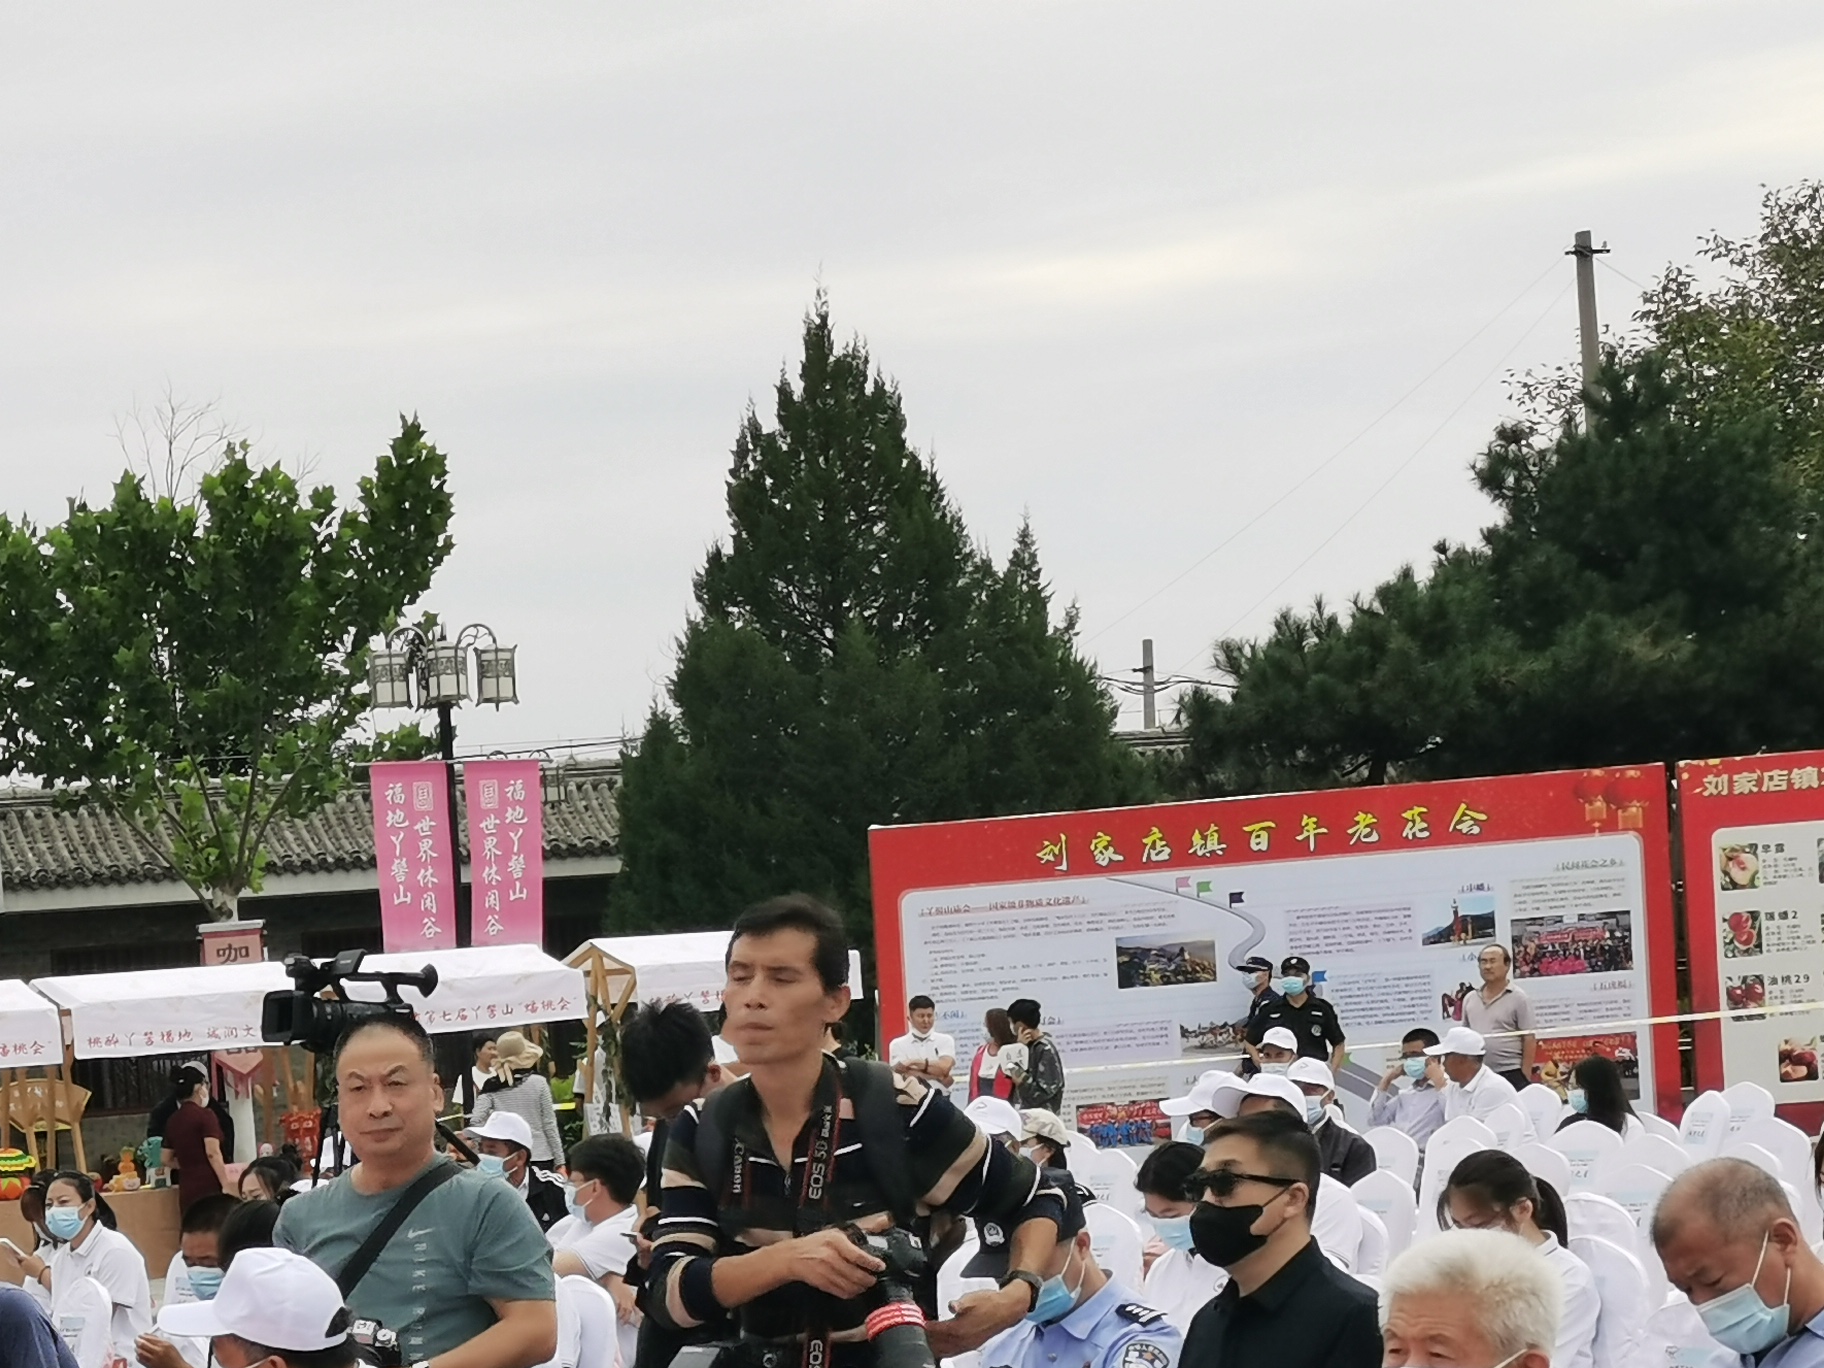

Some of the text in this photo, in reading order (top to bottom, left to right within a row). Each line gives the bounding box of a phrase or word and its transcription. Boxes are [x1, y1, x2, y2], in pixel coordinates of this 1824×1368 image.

[1702, 766, 1824, 797] 刘家店镇
[384, 782, 412, 906] 福地丫髻山
[504, 778, 529, 902] 福地丫髻山
[1035, 801, 1489, 873] 刘家店镇百年老花会
[413, 814, 443, 939] 世界休闲谷
[478, 813, 504, 937] 世界休闲谷
[732, 1138, 746, 1194] Canon
[809, 1167, 826, 1200] EOS
[412, 1242, 427, 1291] NIKE
